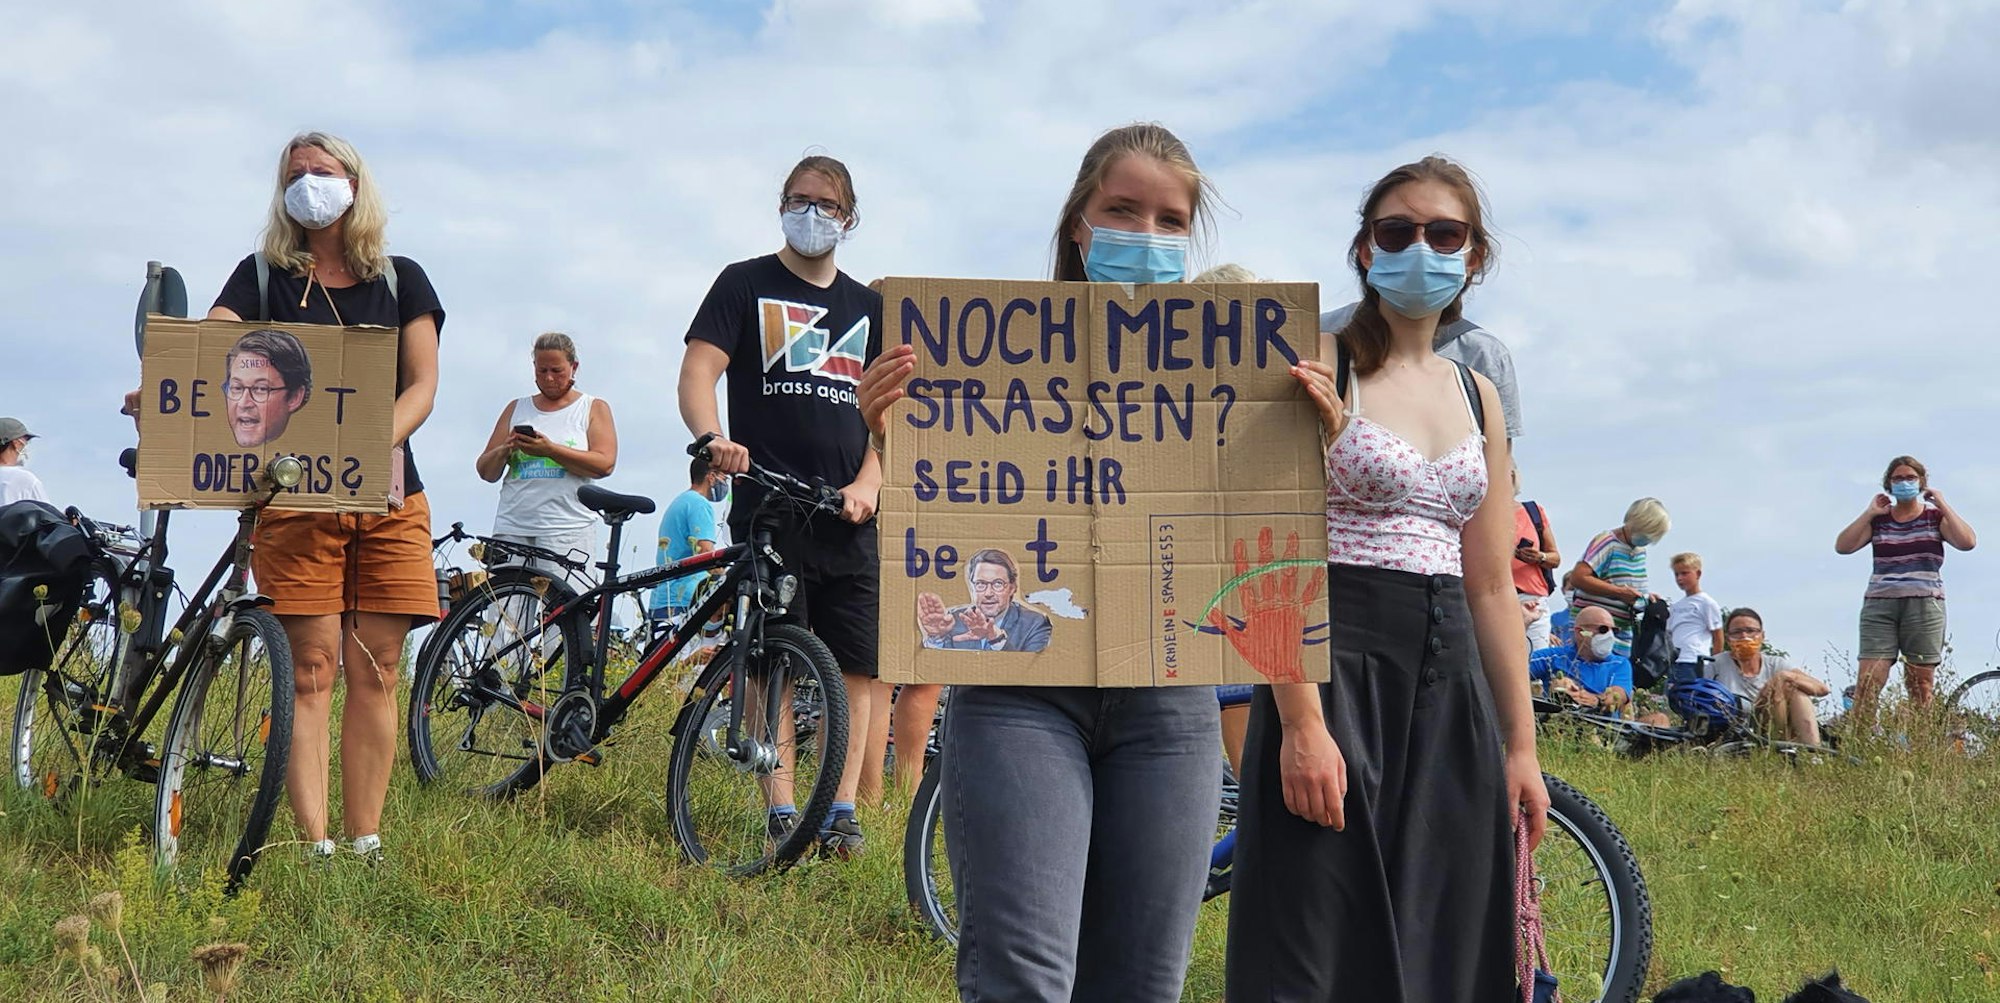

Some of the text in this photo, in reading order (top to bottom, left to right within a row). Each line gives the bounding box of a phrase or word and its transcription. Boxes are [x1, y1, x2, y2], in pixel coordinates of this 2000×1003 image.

[900, 296, 1300, 374] NOCH MEHR
[159, 378, 357, 425] BE T
[762, 376, 813, 396] brass
[192, 453, 260, 493] ODER
[904, 517, 1060, 583] be t
